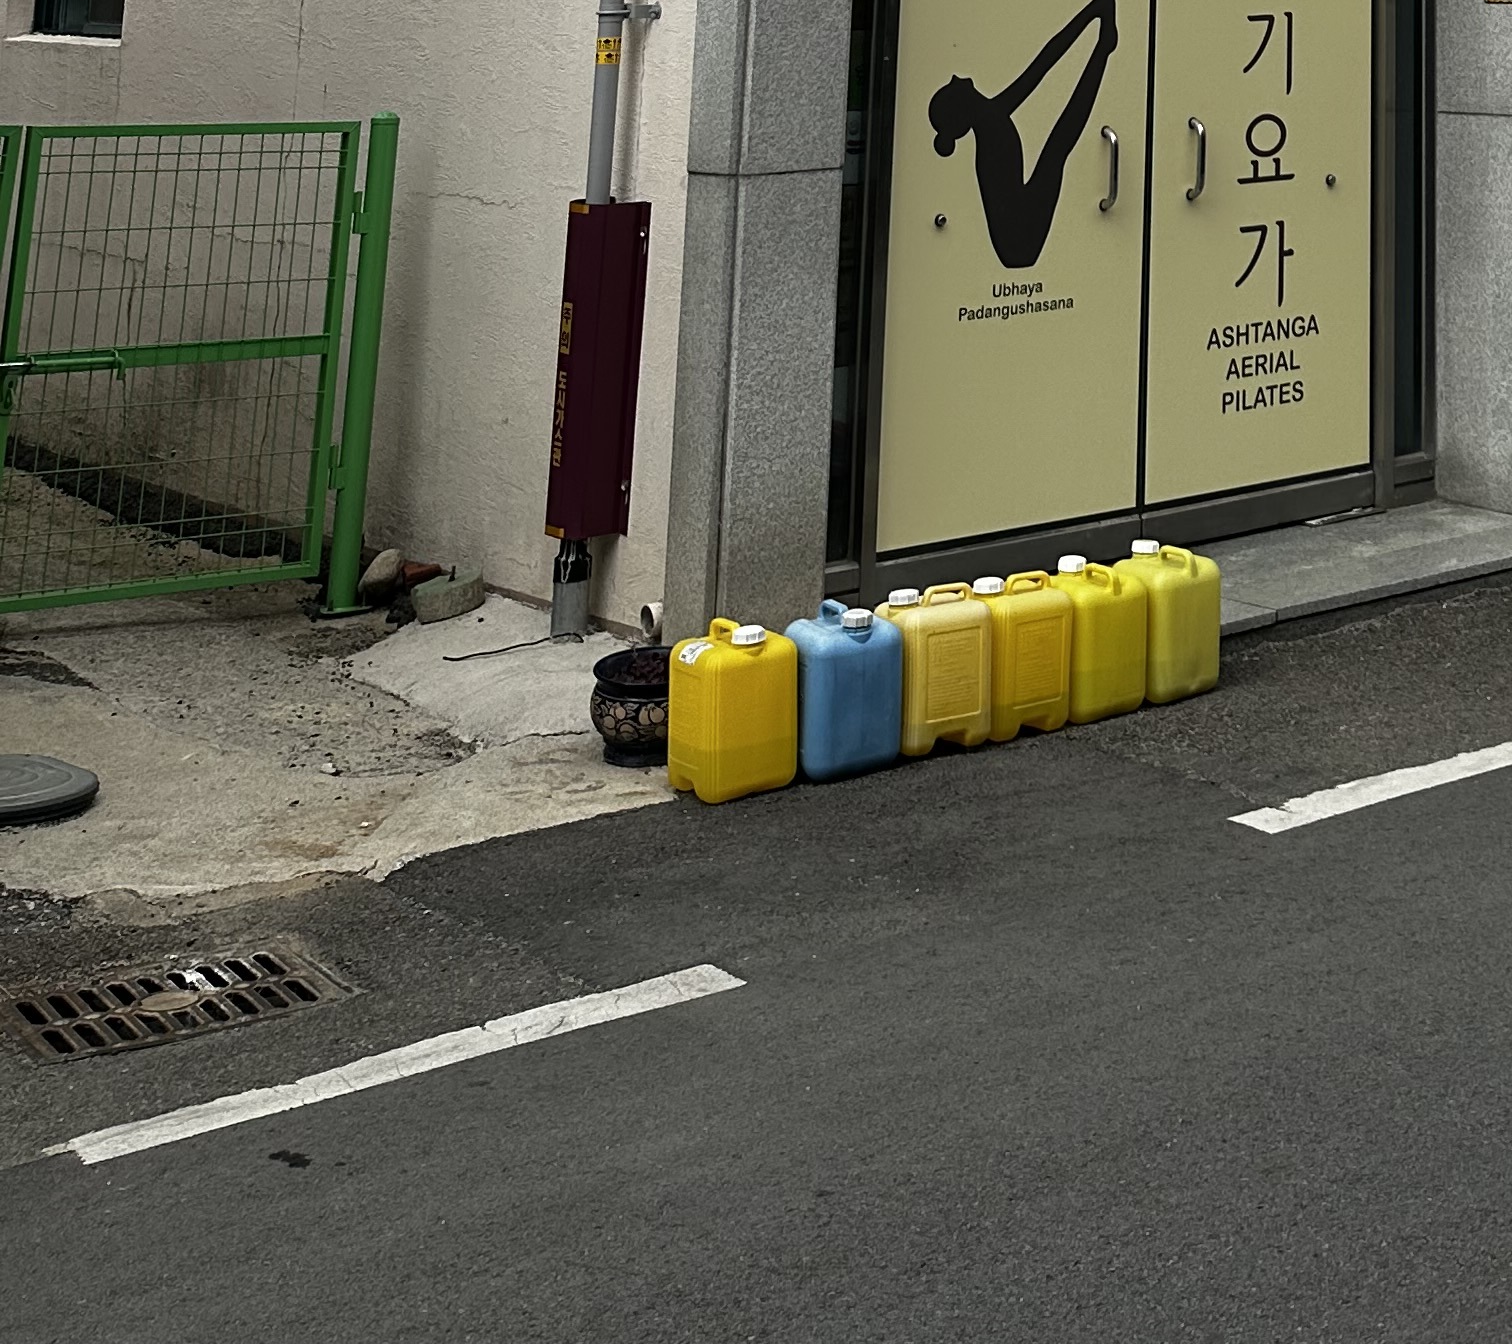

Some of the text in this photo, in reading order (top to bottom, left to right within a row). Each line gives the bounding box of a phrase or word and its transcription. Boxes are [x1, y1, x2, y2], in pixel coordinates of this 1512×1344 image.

[992, 280, 1043, 298] Ubhaya
[958, 296, 1074, 322] Padangushasana
[1206, 313, 1320, 351] ASHTANGA
[1226, 349, 1301, 381] AERIAL
[1222, 380, 1304, 415] PILATES
